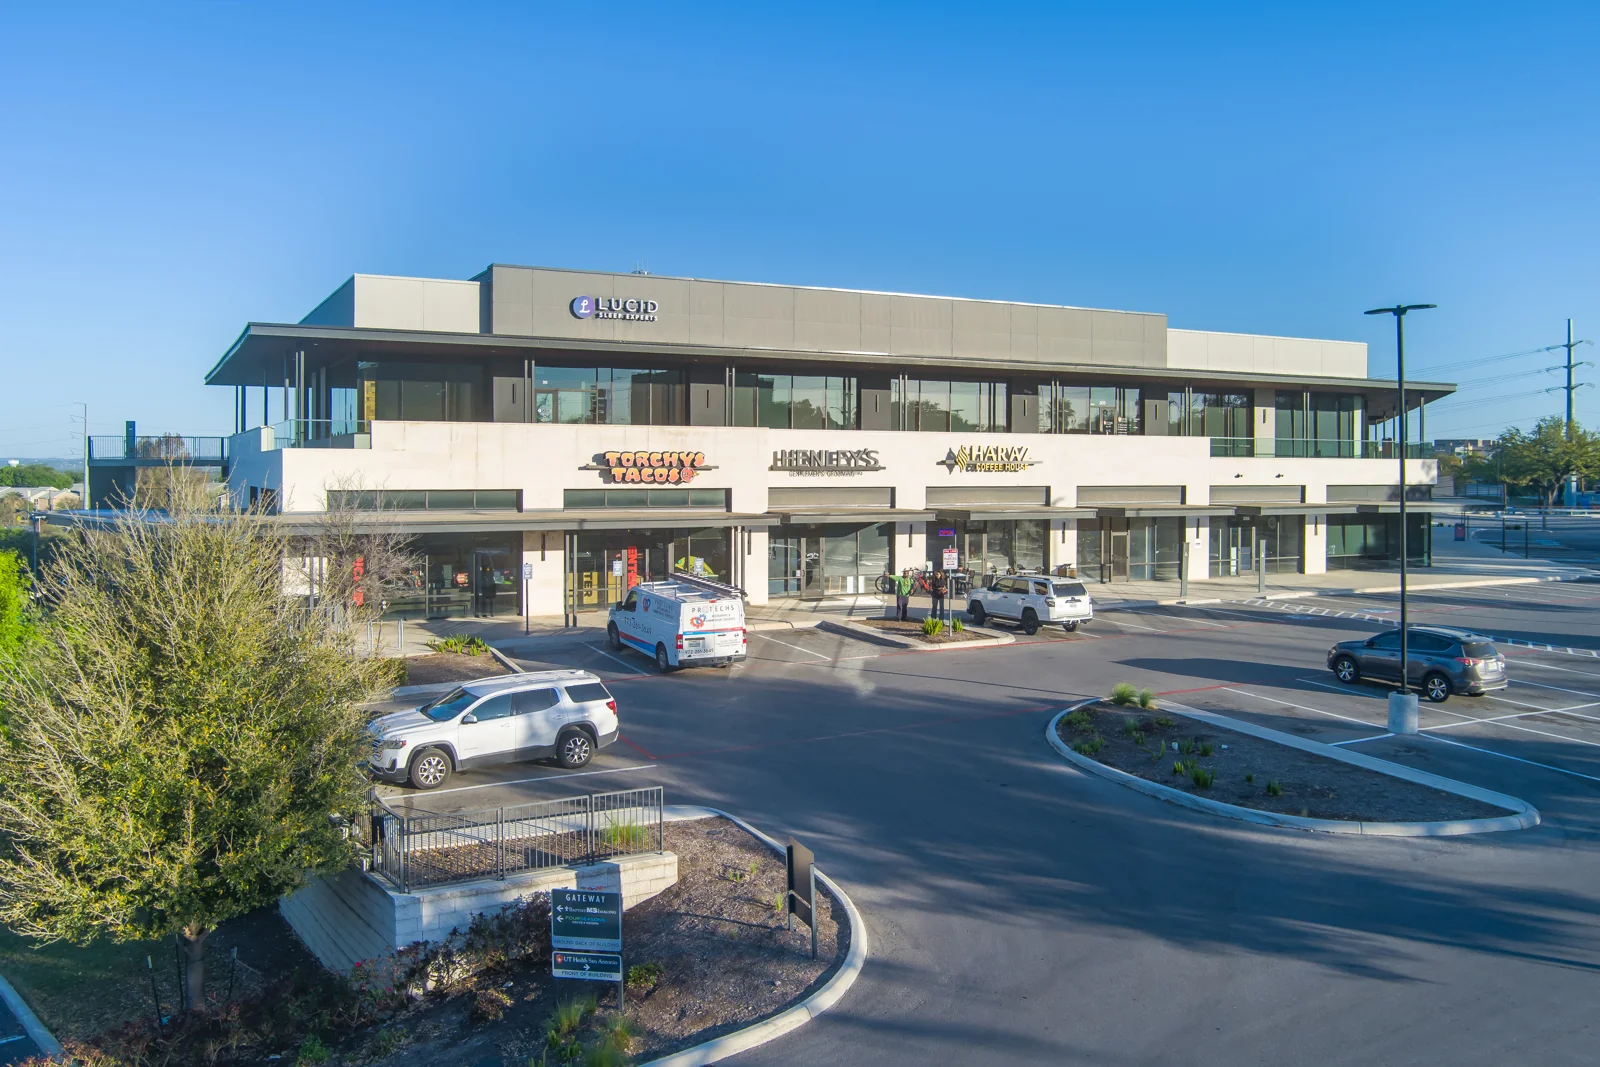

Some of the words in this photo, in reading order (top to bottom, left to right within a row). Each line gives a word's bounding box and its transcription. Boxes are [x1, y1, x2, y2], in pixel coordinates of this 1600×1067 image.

[598, 296, 659, 313] LUCID
[626, 313, 658, 321] EXPERTS
[773, 448, 879, 467] HENLEY'S
[969, 445, 1031, 461] HARAZ
[611, 467, 680, 482] TACOS
[976, 463, 1003, 471] COFFEE
[1005, 463, 1028, 471] HOUSE
[565, 893, 606, 903] GATEWAY
